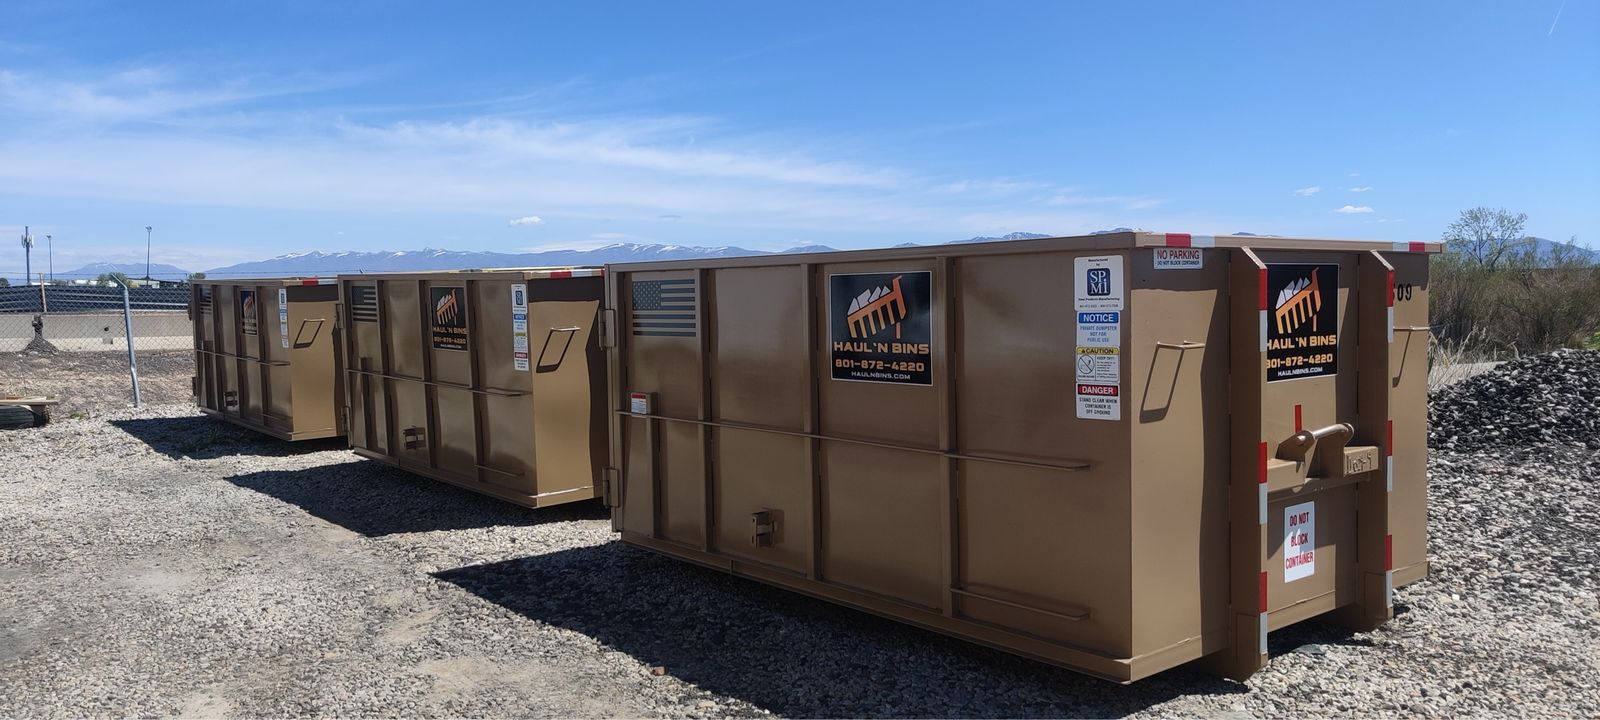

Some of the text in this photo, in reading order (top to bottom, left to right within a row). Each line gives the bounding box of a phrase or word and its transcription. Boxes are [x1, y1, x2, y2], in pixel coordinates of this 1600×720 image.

[1157, 250, 1199, 259] NO PARKING
[1393, 283, 1411, 301] 09
[1084, 314, 1114, 322] NOTICE
[834, 341, 872, 352] HAUL
[892, 343, 929, 354] BINS
[1267, 338, 1295, 350] HAUL
[1310, 335, 1336, 346] BINS
[835, 359, 924, 372] 801-872-4220
[1278, 366, 1323, 376] HAULNBINS.COM
[851, 371, 911, 379] HAULNBINS.COM
[1082, 386, 1113, 394] DANGER
[1290, 512, 1309, 526] DO NOT
[1291, 533, 1308, 547] BLOCK
[1286, 552, 1313, 569] CONTAINER
